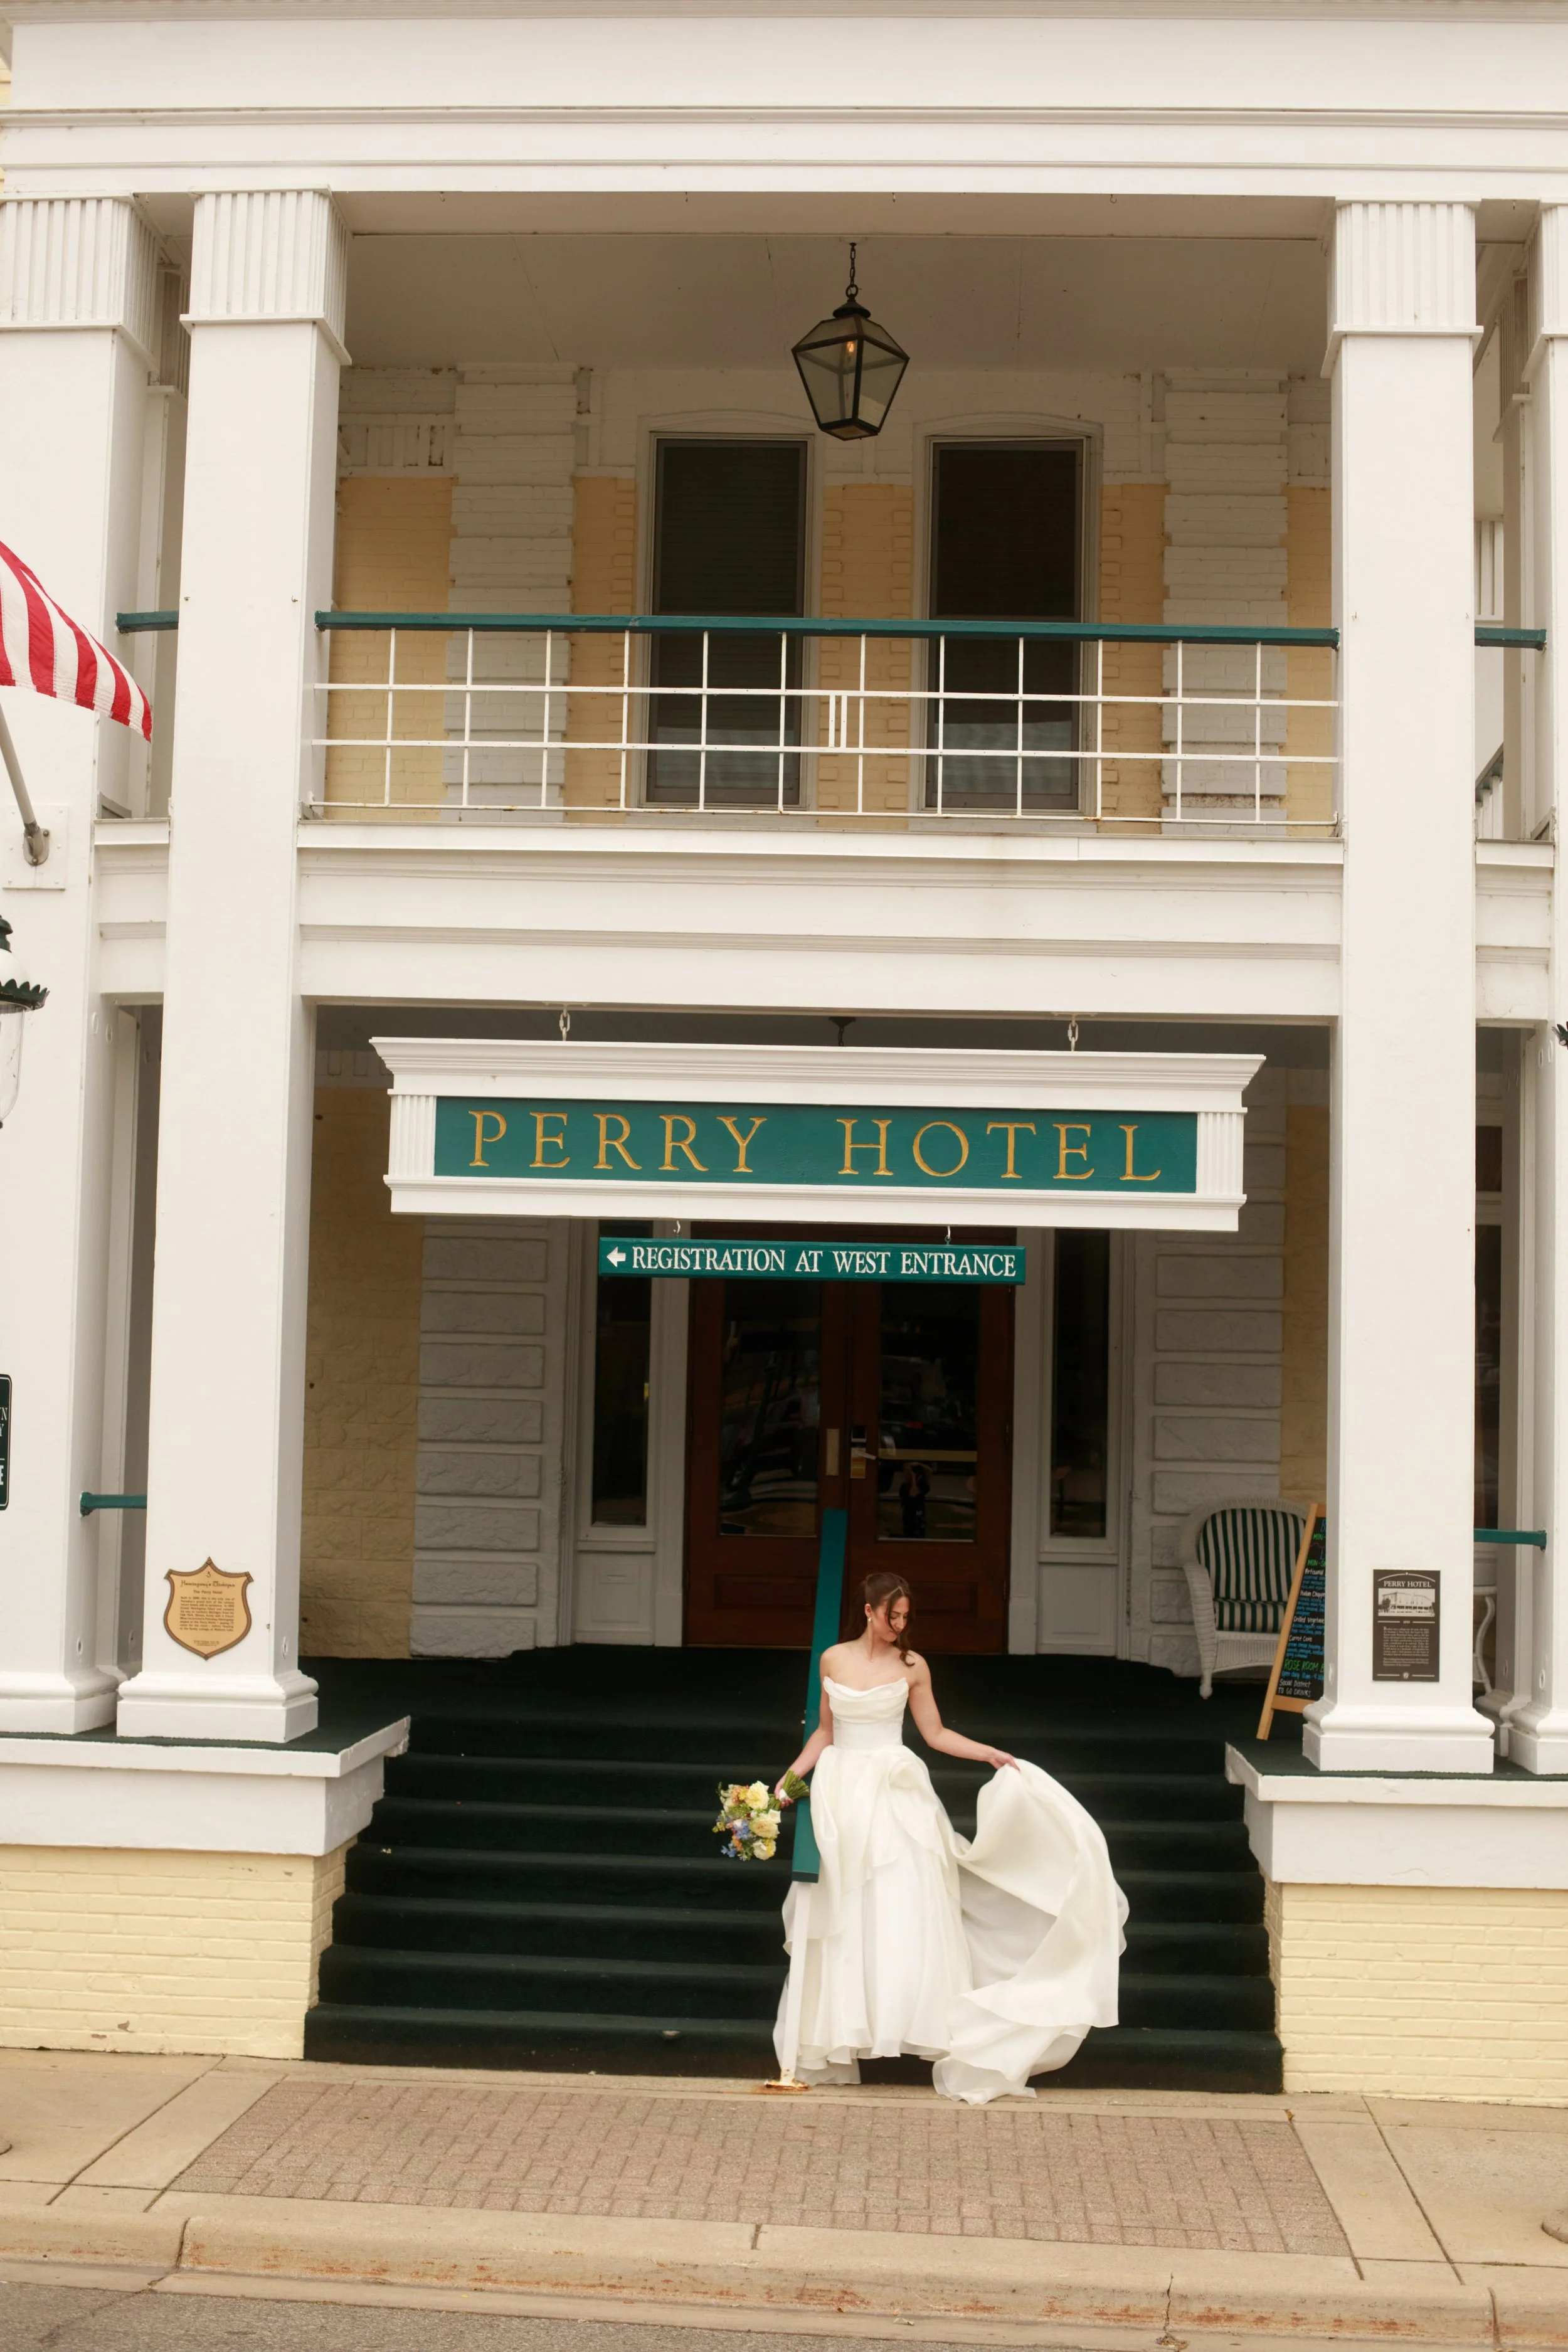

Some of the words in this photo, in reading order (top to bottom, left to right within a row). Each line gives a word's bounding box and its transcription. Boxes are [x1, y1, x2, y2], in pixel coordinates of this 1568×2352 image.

[469, 1110, 767, 1172] PERRY
[837, 1118, 1161, 1180] HOTEL
[632, 1246, 785, 1271] REGISTRATION
[795, 1250, 823, 1273] AT
[832, 1251, 891, 1274] WEST
[901, 1253, 1015, 1277] ENTRANCE
[1285, 1658, 1300, 1671] ROSE
[1301, 1661, 1319, 1671] ROOM
[1279, 1678, 1293, 1687] Social
[1293, 1680, 1311, 1688] District
[1293, 1688, 1311, 1698] DRINKS
